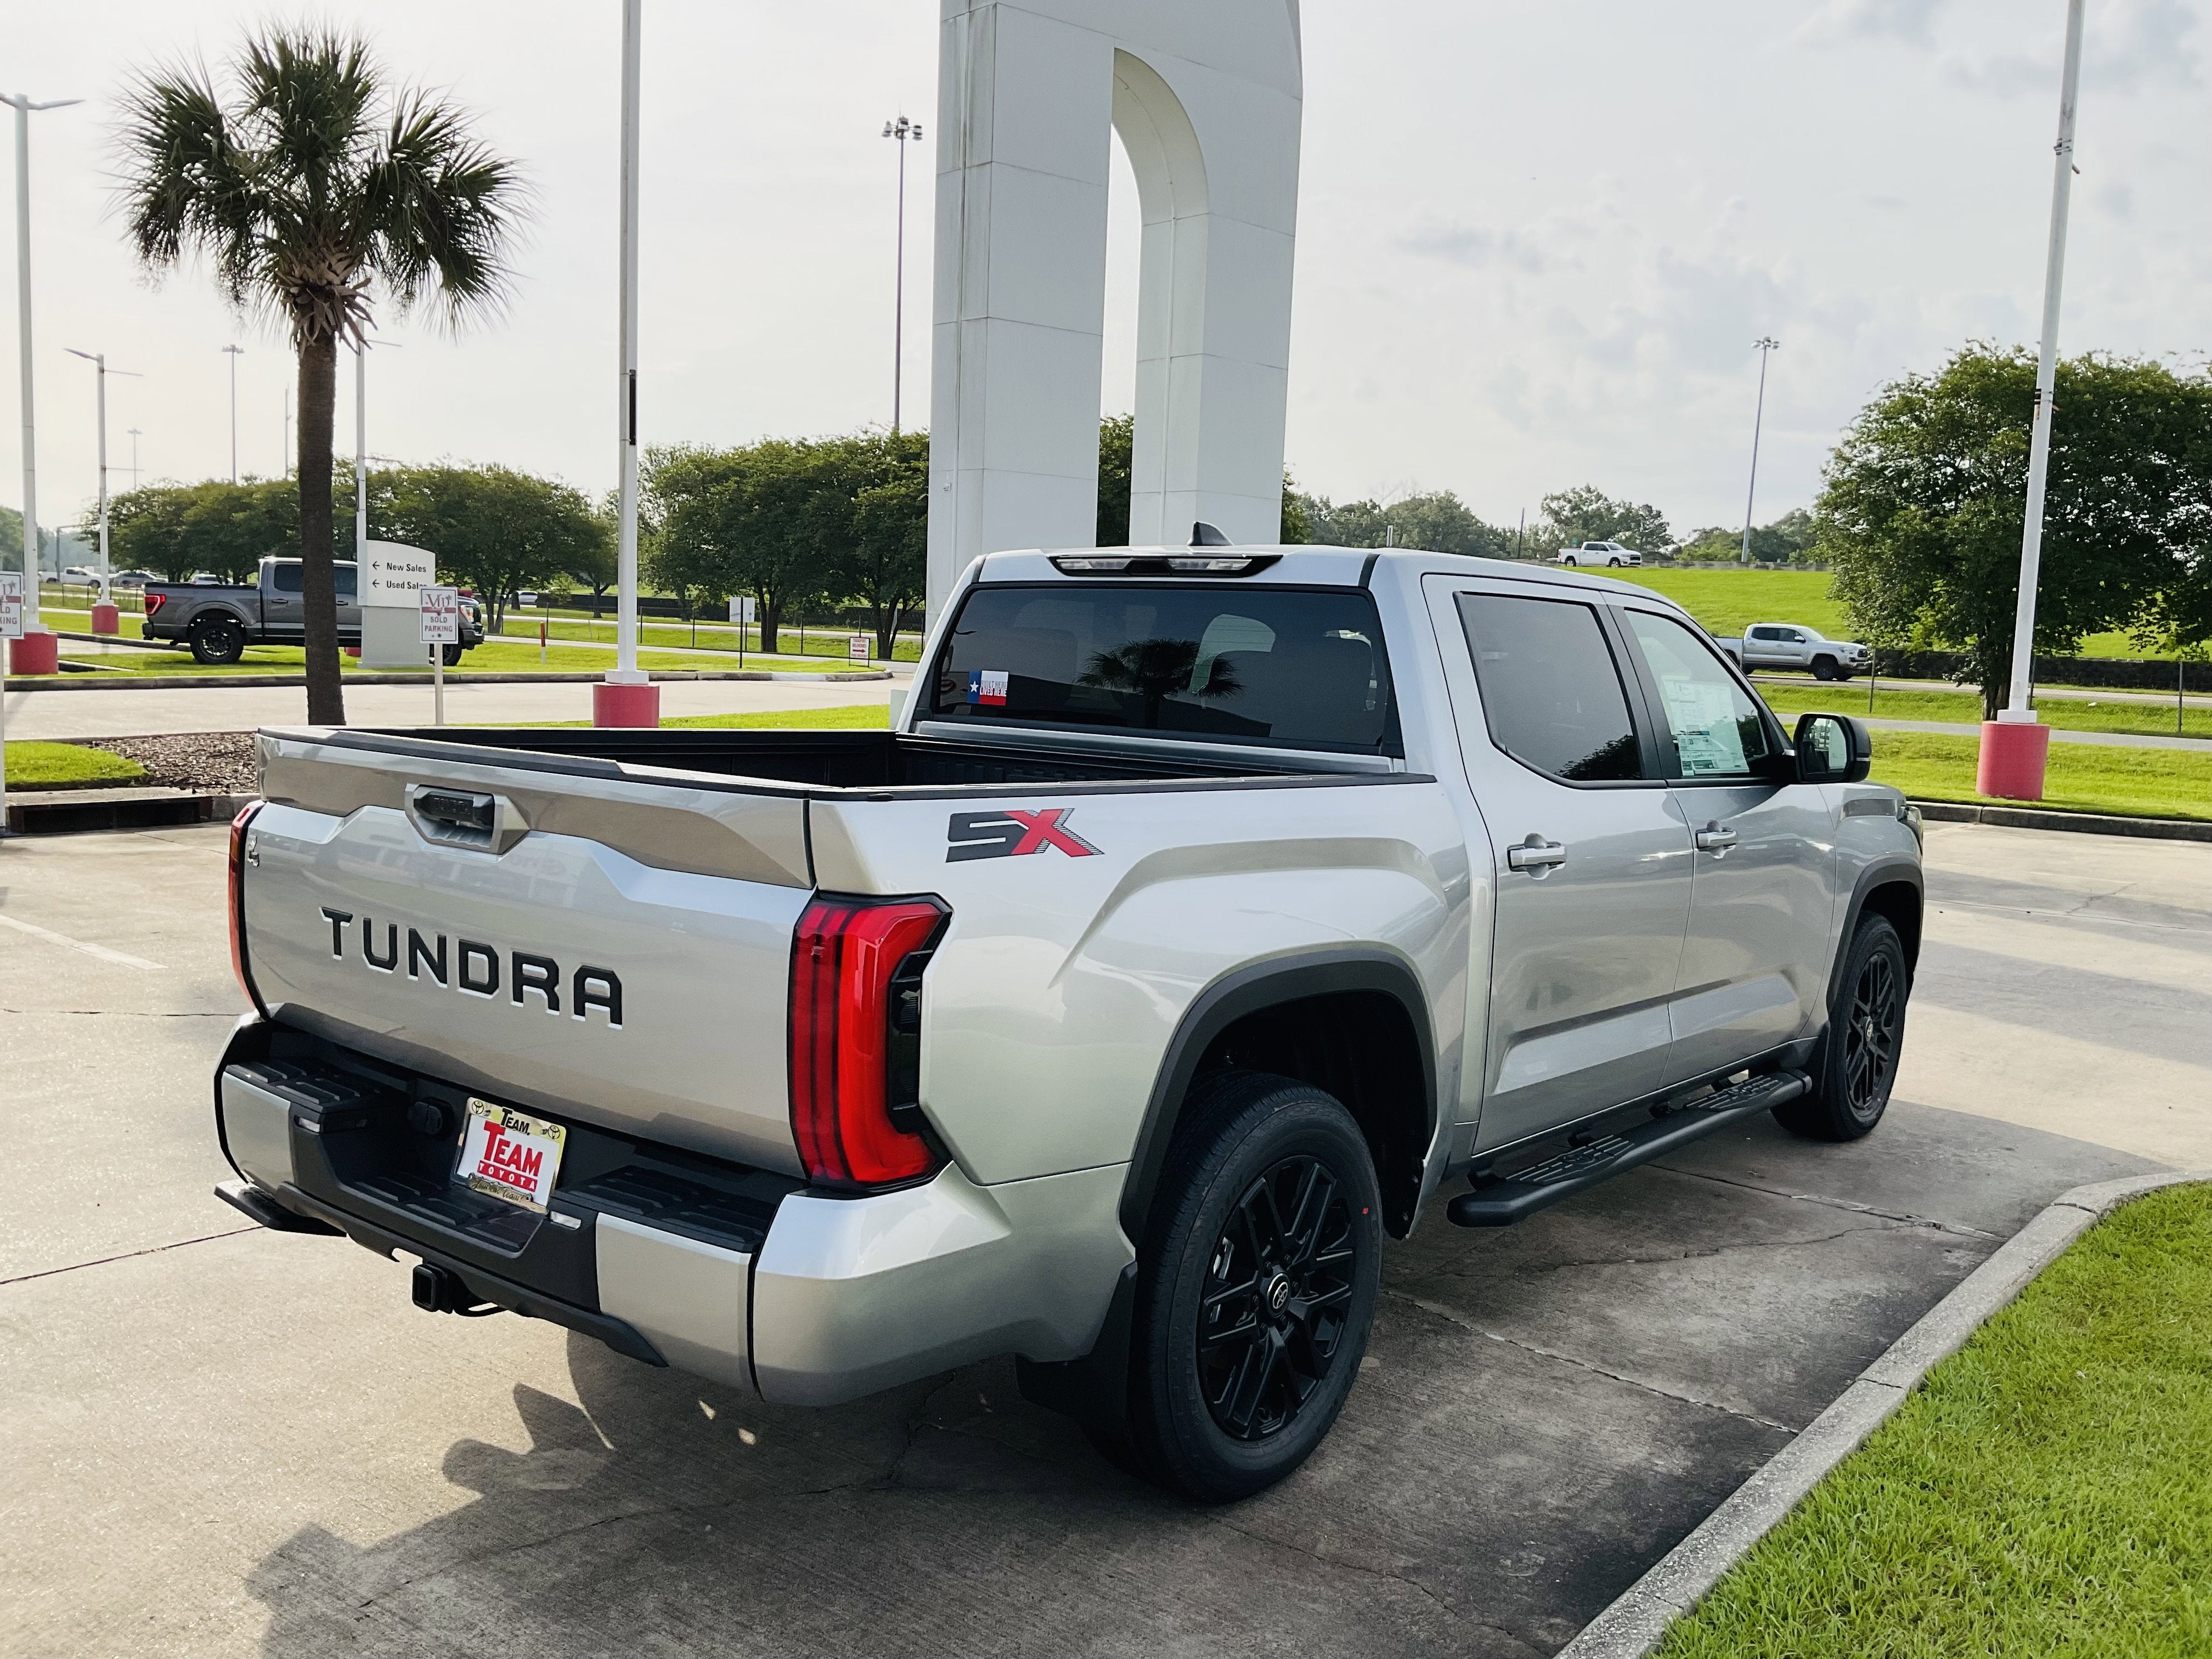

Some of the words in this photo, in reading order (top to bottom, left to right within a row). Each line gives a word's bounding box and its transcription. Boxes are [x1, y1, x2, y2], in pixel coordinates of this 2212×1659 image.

[387, 562, 404, 571] New
[406, 563, 426, 572] Sales
[386, 580, 405, 589] Used
[407, 582, 427, 590] Sal
[981, 680, 994, 689] BUILT
[995, 681, 1007, 689] HERE
[980, 687, 994, 696] LIVES
[994, 688, 1007, 697] HERE
[320, 906, 623, 1027] TUNDRA
[483, 1120, 543, 1177] TEAM
[478, 1162, 535, 1189] TOYOTA
